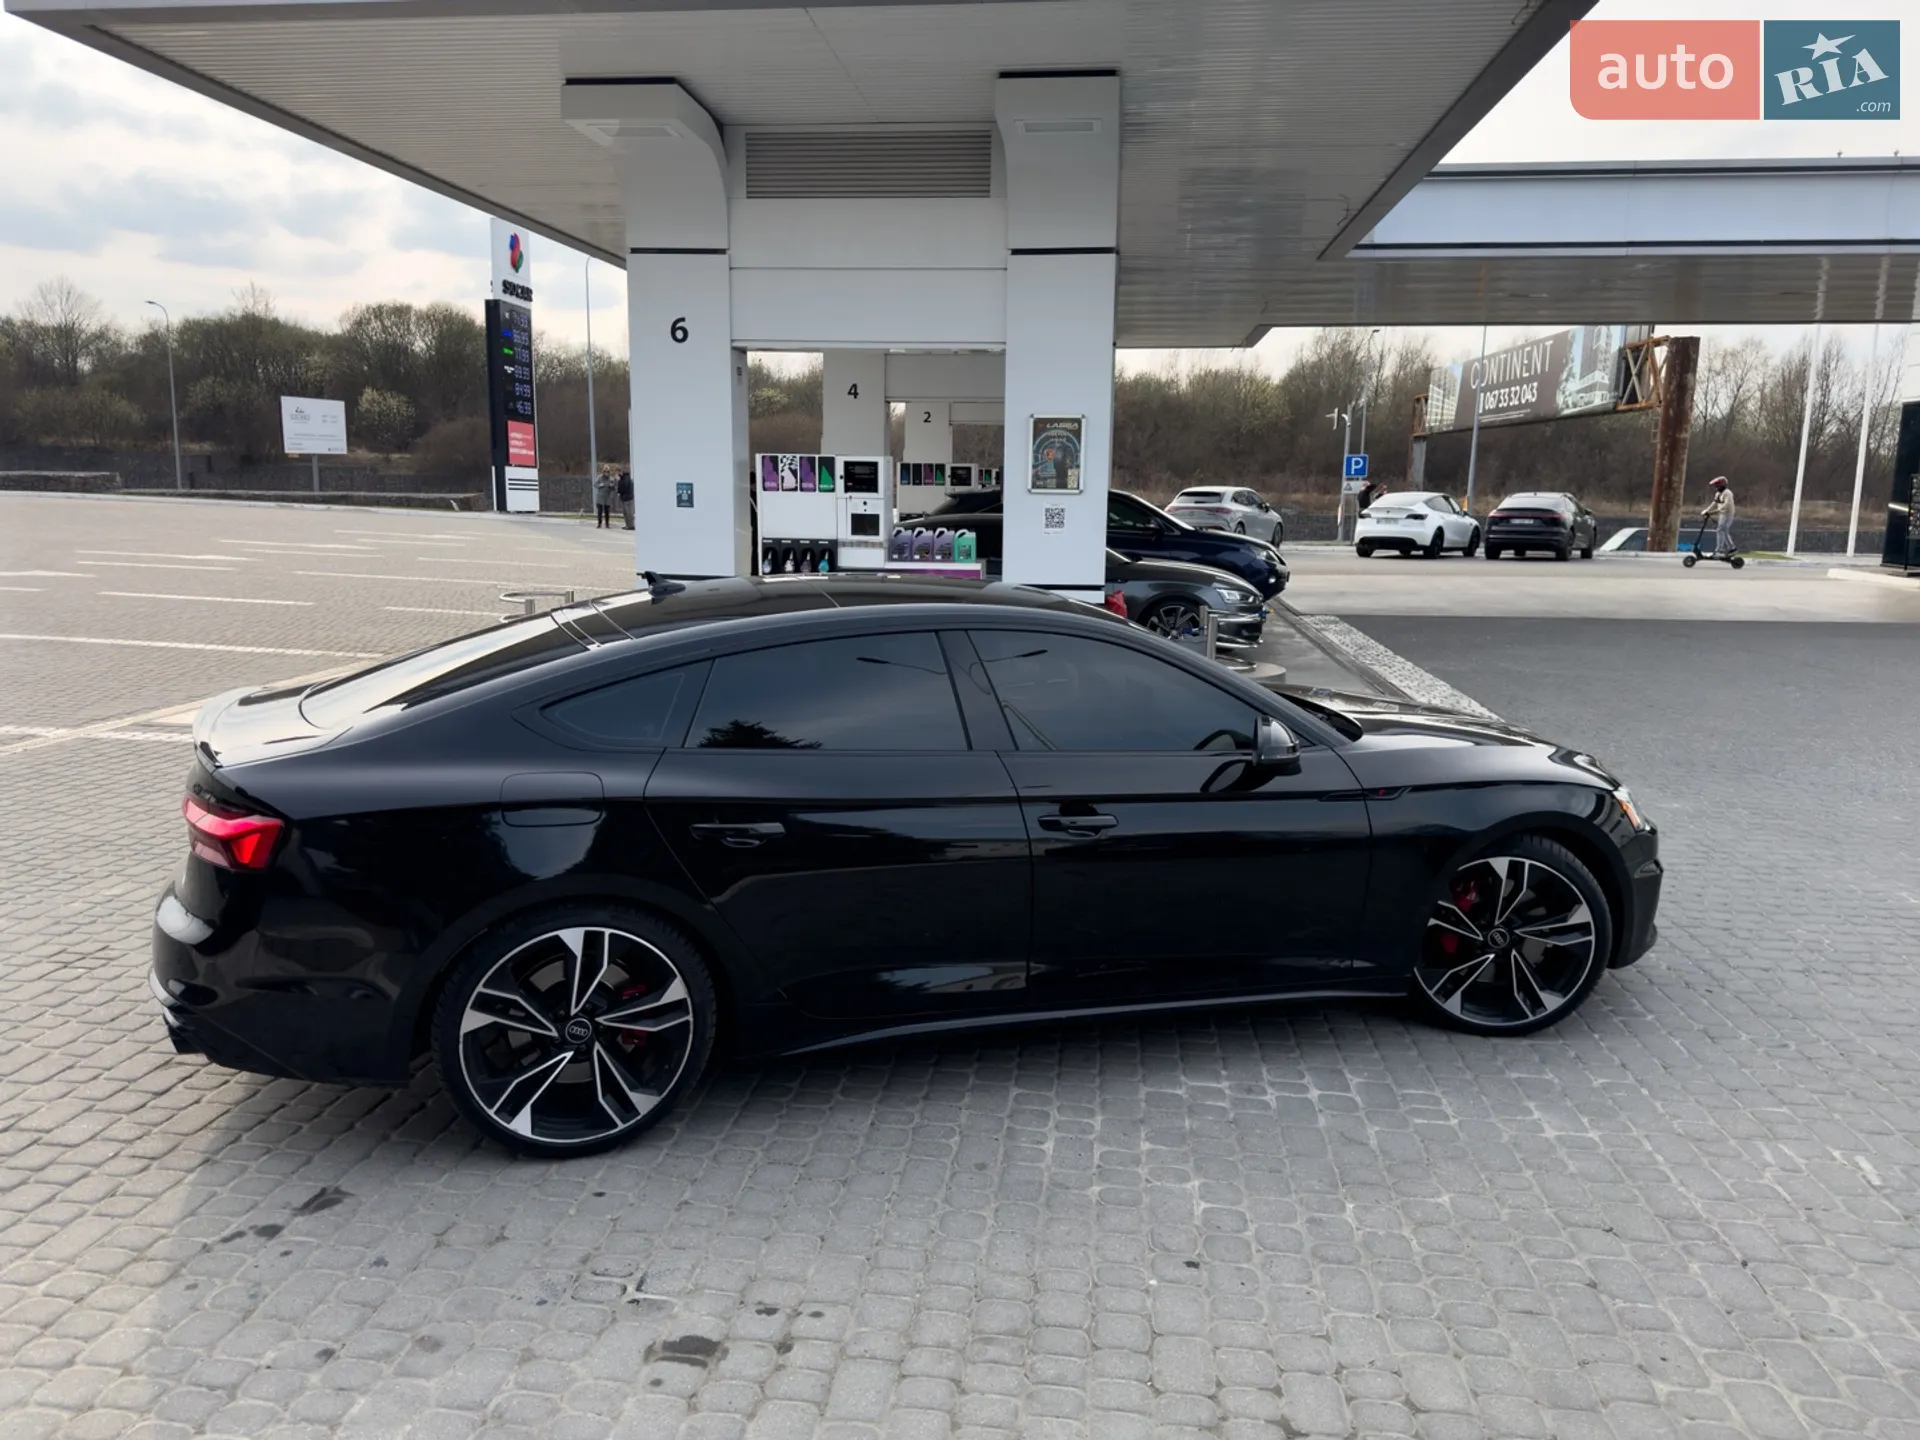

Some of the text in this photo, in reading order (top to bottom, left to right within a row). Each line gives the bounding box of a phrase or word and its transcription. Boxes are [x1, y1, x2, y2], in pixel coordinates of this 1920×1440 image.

[671, 317, 689, 343] 6
[1470, 340, 1554, 389] CONTINENT
[847, 383, 859, 399] 4
[923, 411, 932, 423] 2
[1351, 457, 1364, 475] P
